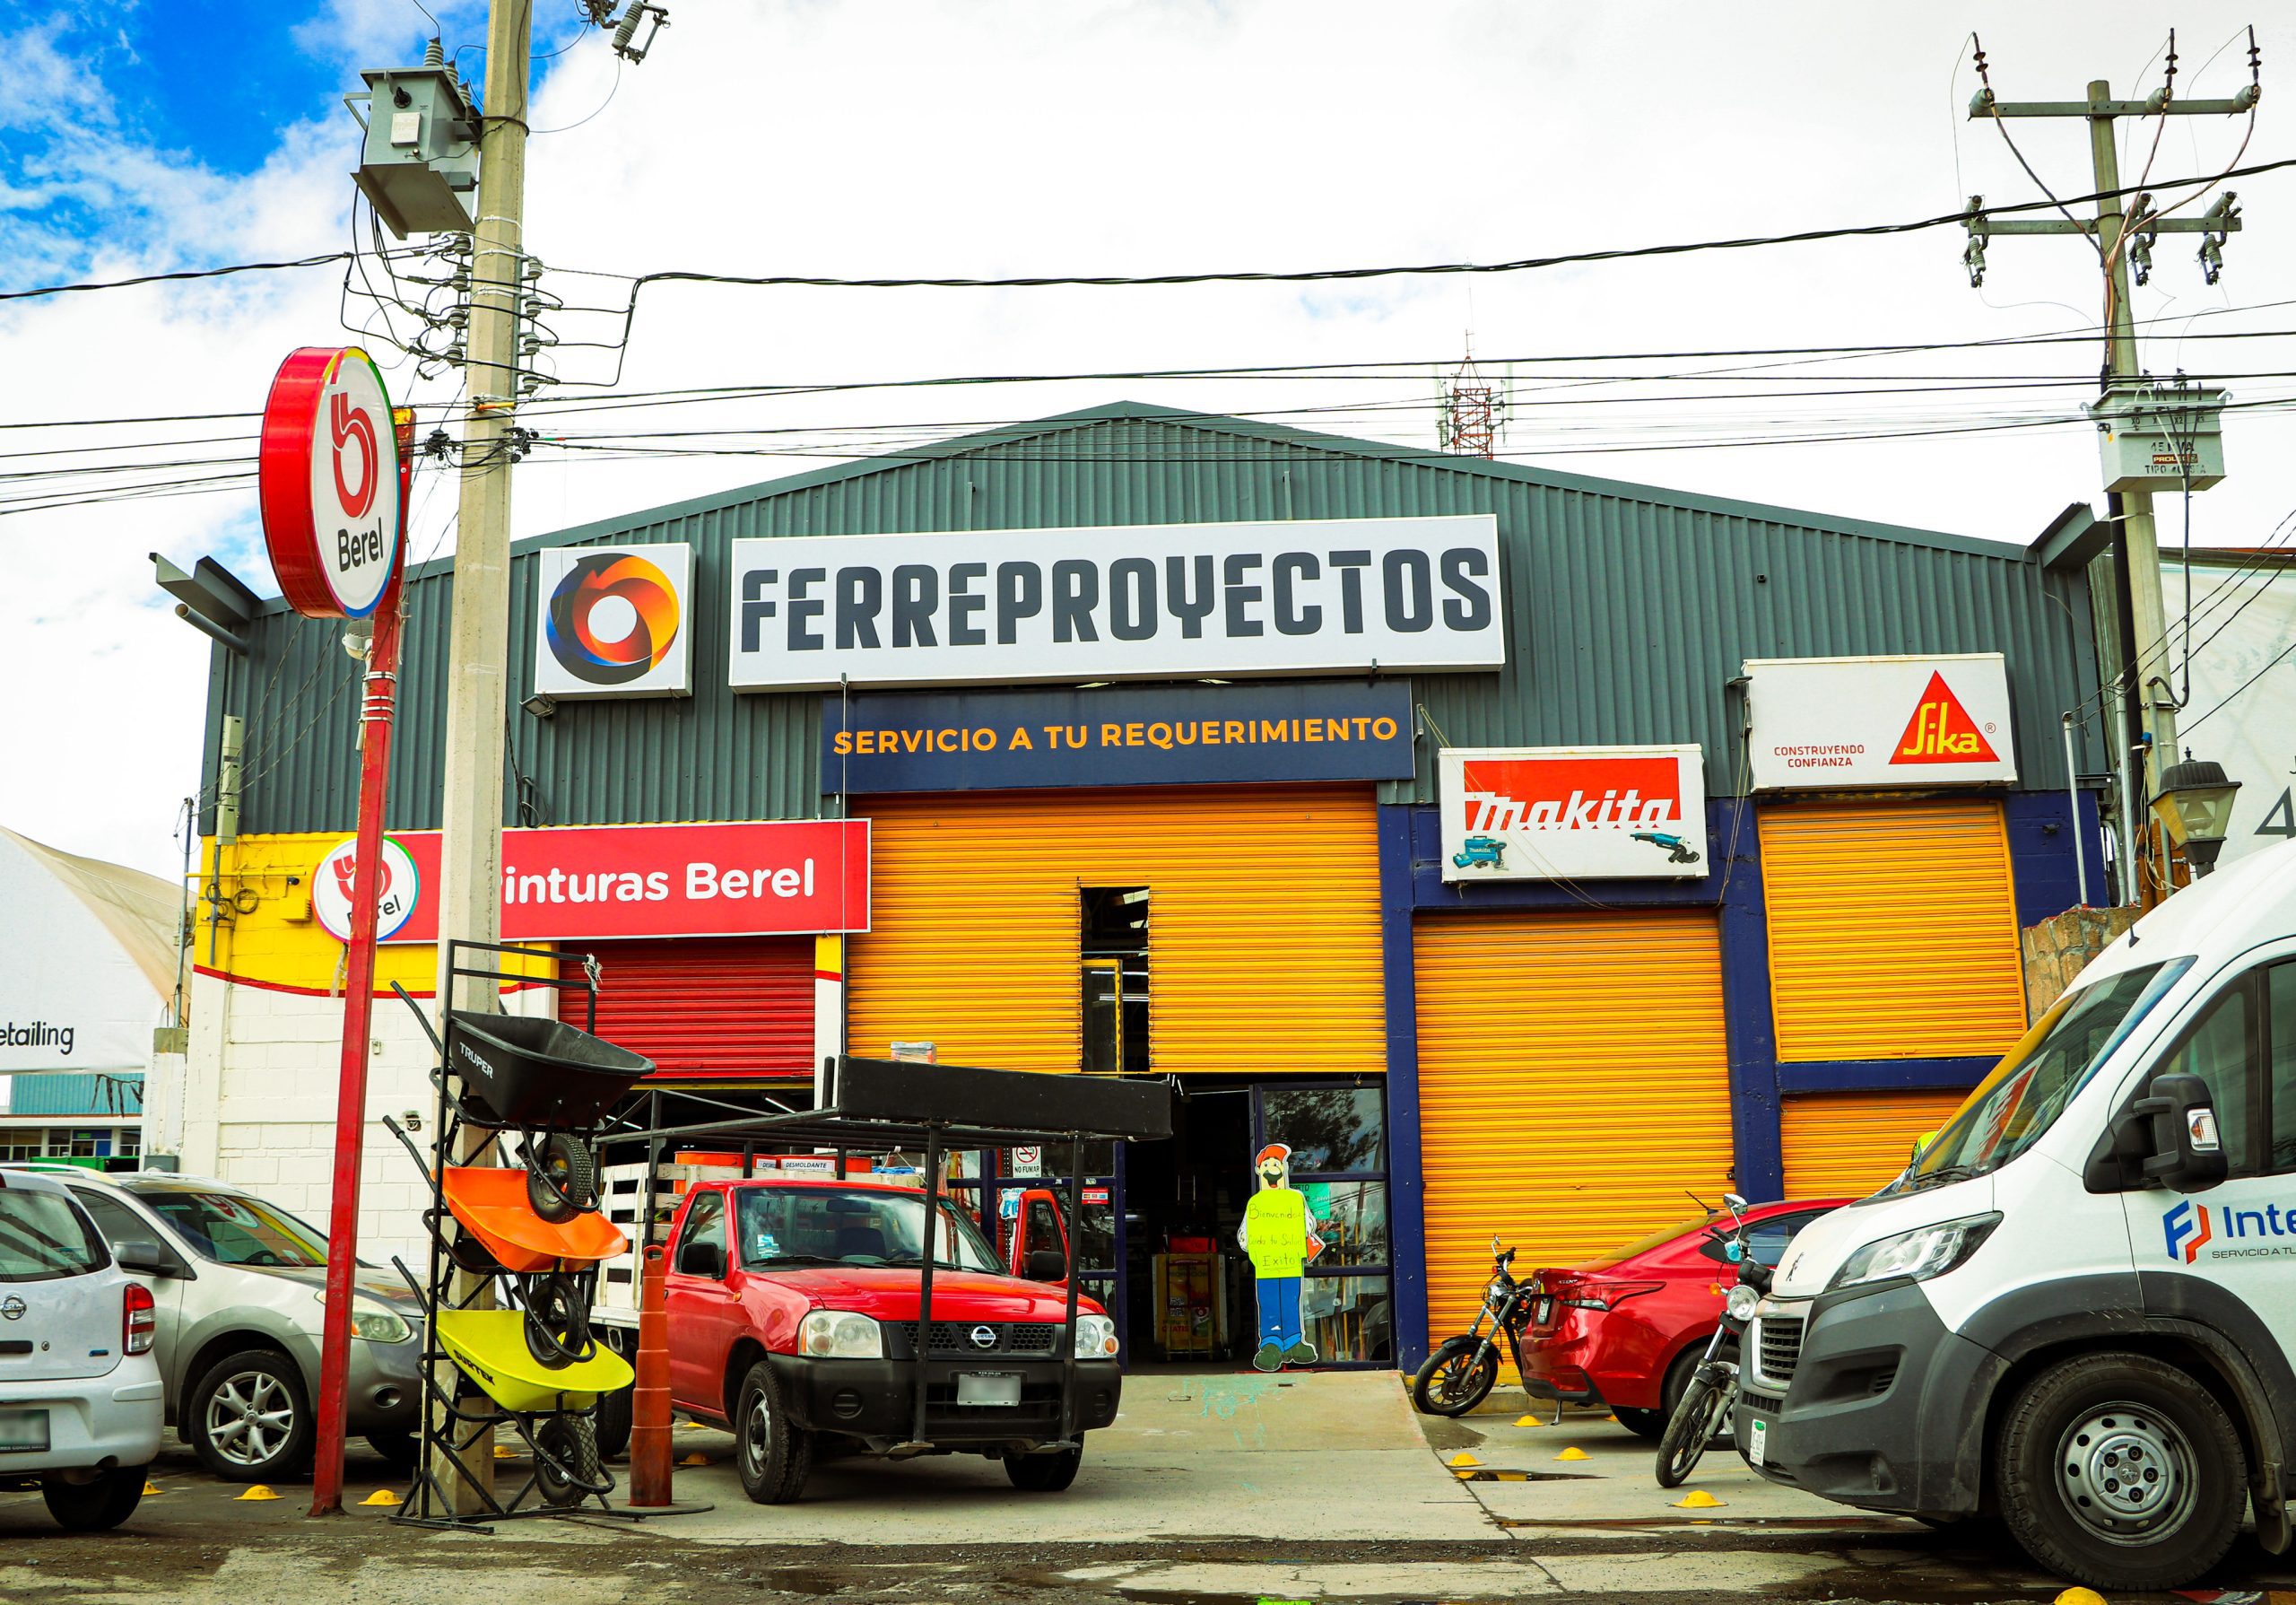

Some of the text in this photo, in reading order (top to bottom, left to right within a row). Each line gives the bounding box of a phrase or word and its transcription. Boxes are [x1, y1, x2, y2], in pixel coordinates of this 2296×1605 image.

[338, 517, 384, 572] Berel
[741, 547, 1492, 653] FERREPROYECTOS
[832, 717, 1397, 755] SERVICIO A TU REQUERIMIENTO
[1902, 702, 1980, 755] Sika
[1774, 744, 1865, 756] CONSTRUYENDO
[1787, 757, 1853, 769] CONFIANZA
[500, 858, 814, 904] inturas Berel
[459, 1041, 494, 1079] TRUPER
[1022, 1165, 1040, 1173] FUMAR
[2212, 1248, 2269, 1259] SERVICIO
